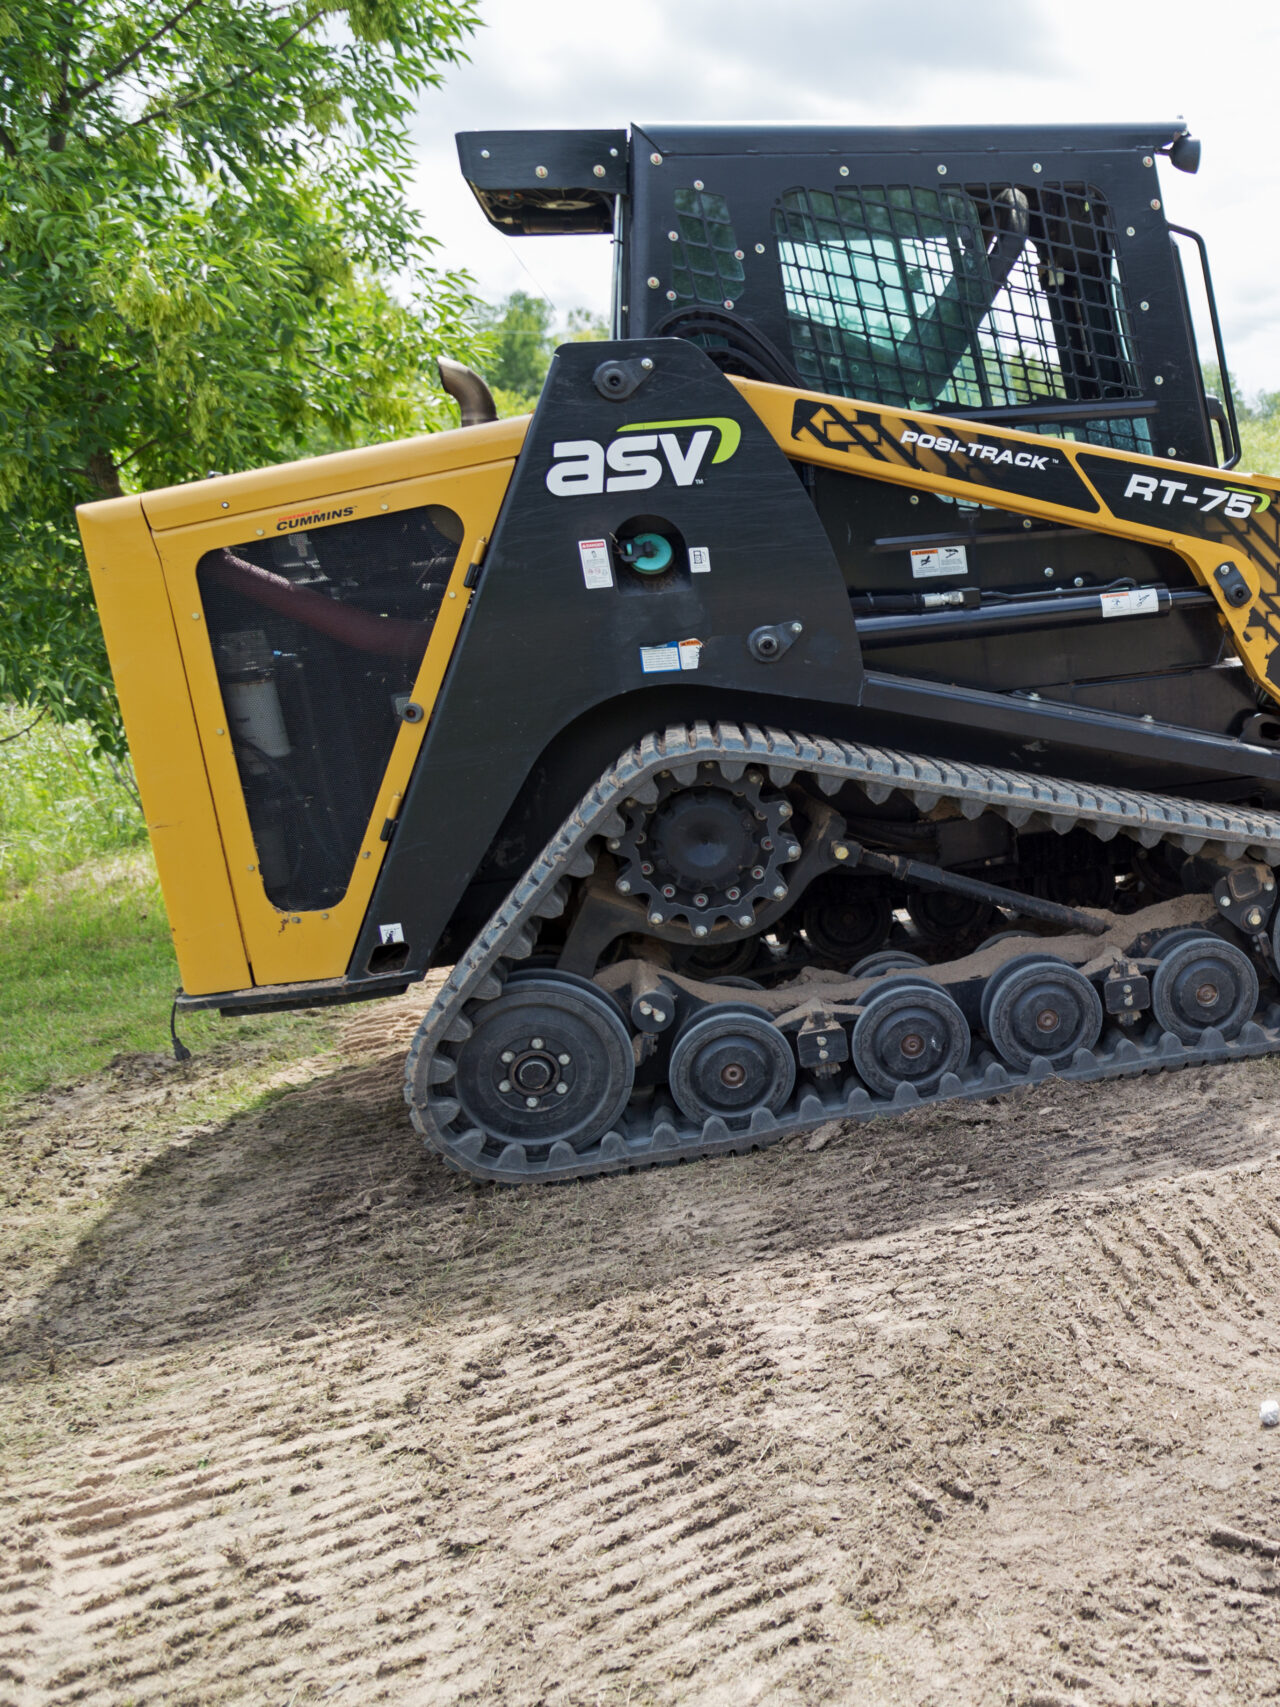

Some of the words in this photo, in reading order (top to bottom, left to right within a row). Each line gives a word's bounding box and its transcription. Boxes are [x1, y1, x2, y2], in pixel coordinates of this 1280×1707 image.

[900, 430, 1050, 471] POSI-TRACK
[1123, 473, 1256, 519] RT-75
[276, 507, 354, 531] CUMMINS
